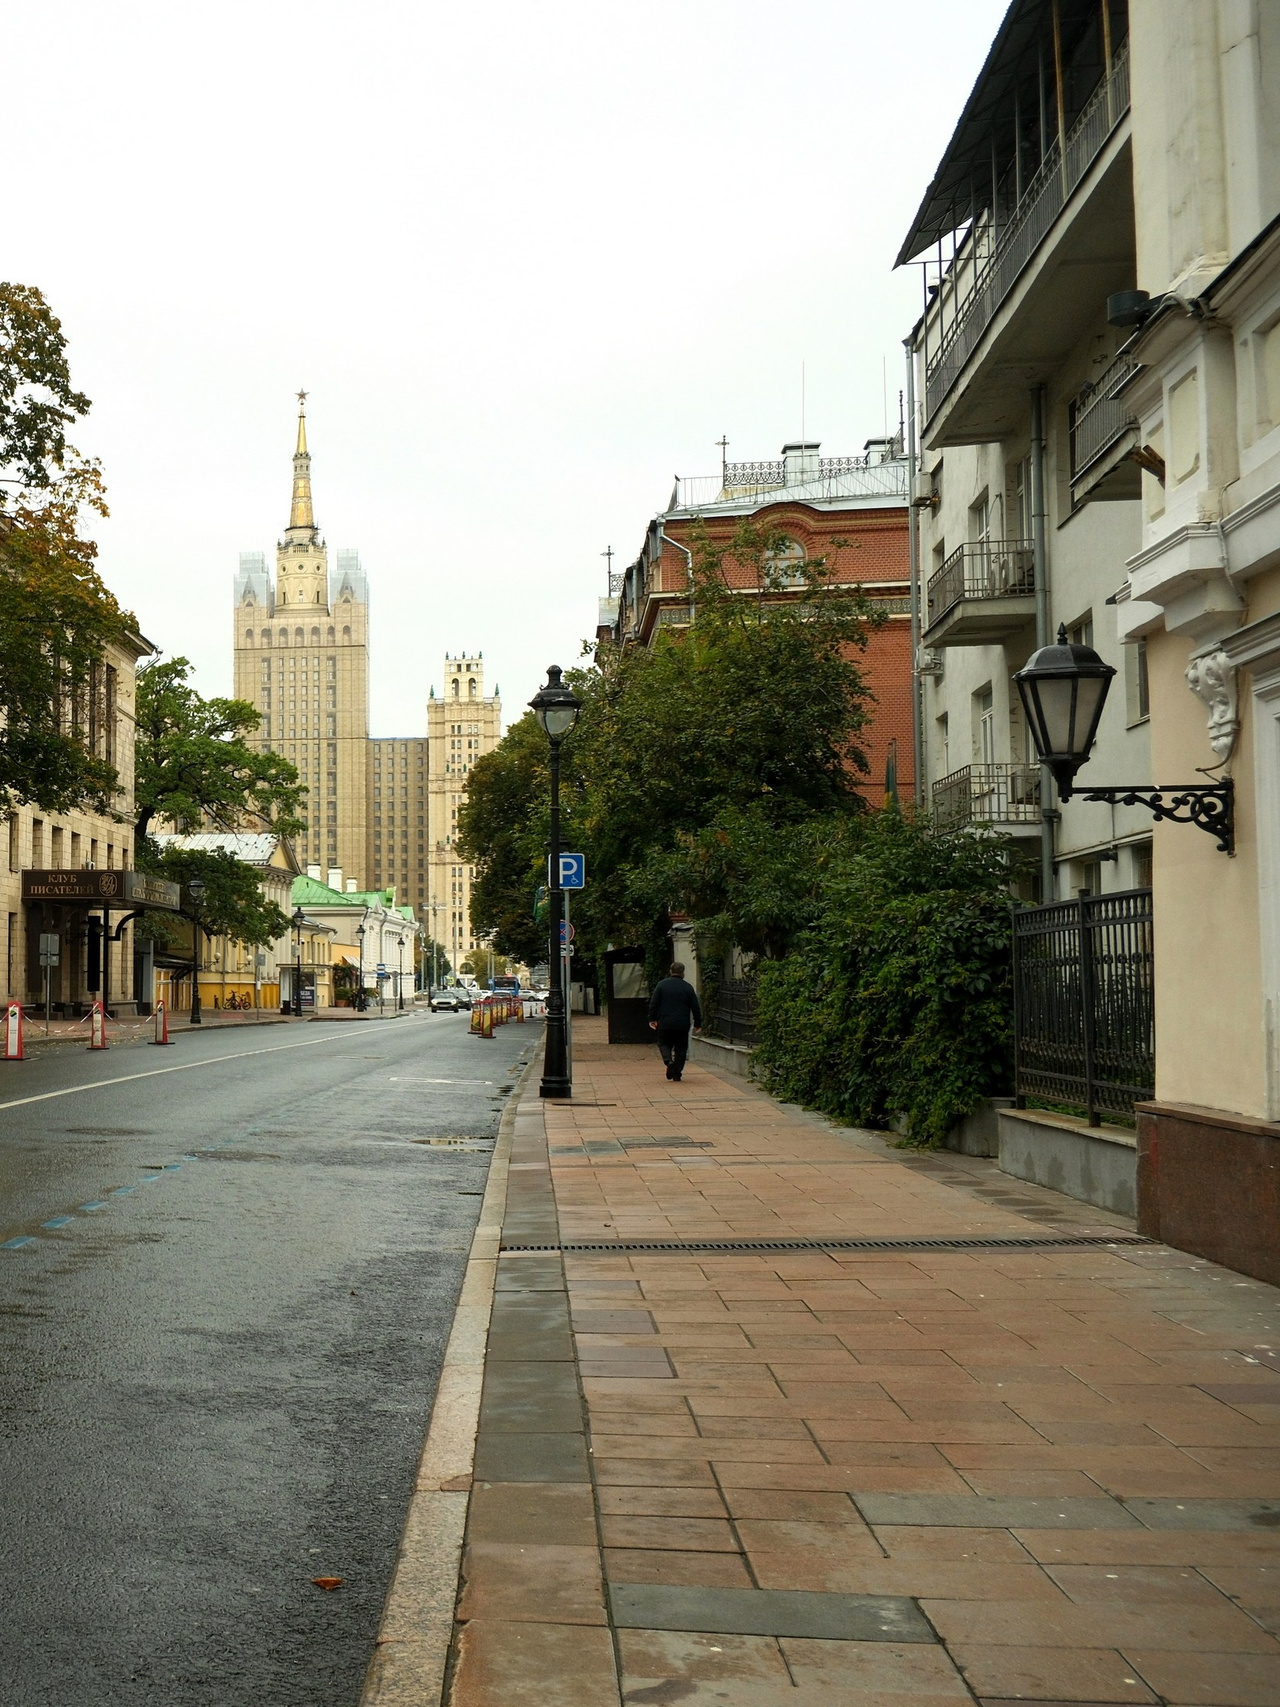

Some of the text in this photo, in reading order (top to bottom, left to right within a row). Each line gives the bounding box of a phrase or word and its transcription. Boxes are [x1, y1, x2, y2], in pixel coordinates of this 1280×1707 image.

[559, 857, 578, 884] P
[48, 874, 77, 883] КЛУБ
[30, 884, 94, 894] ПИСАТЕЛЕЙ
